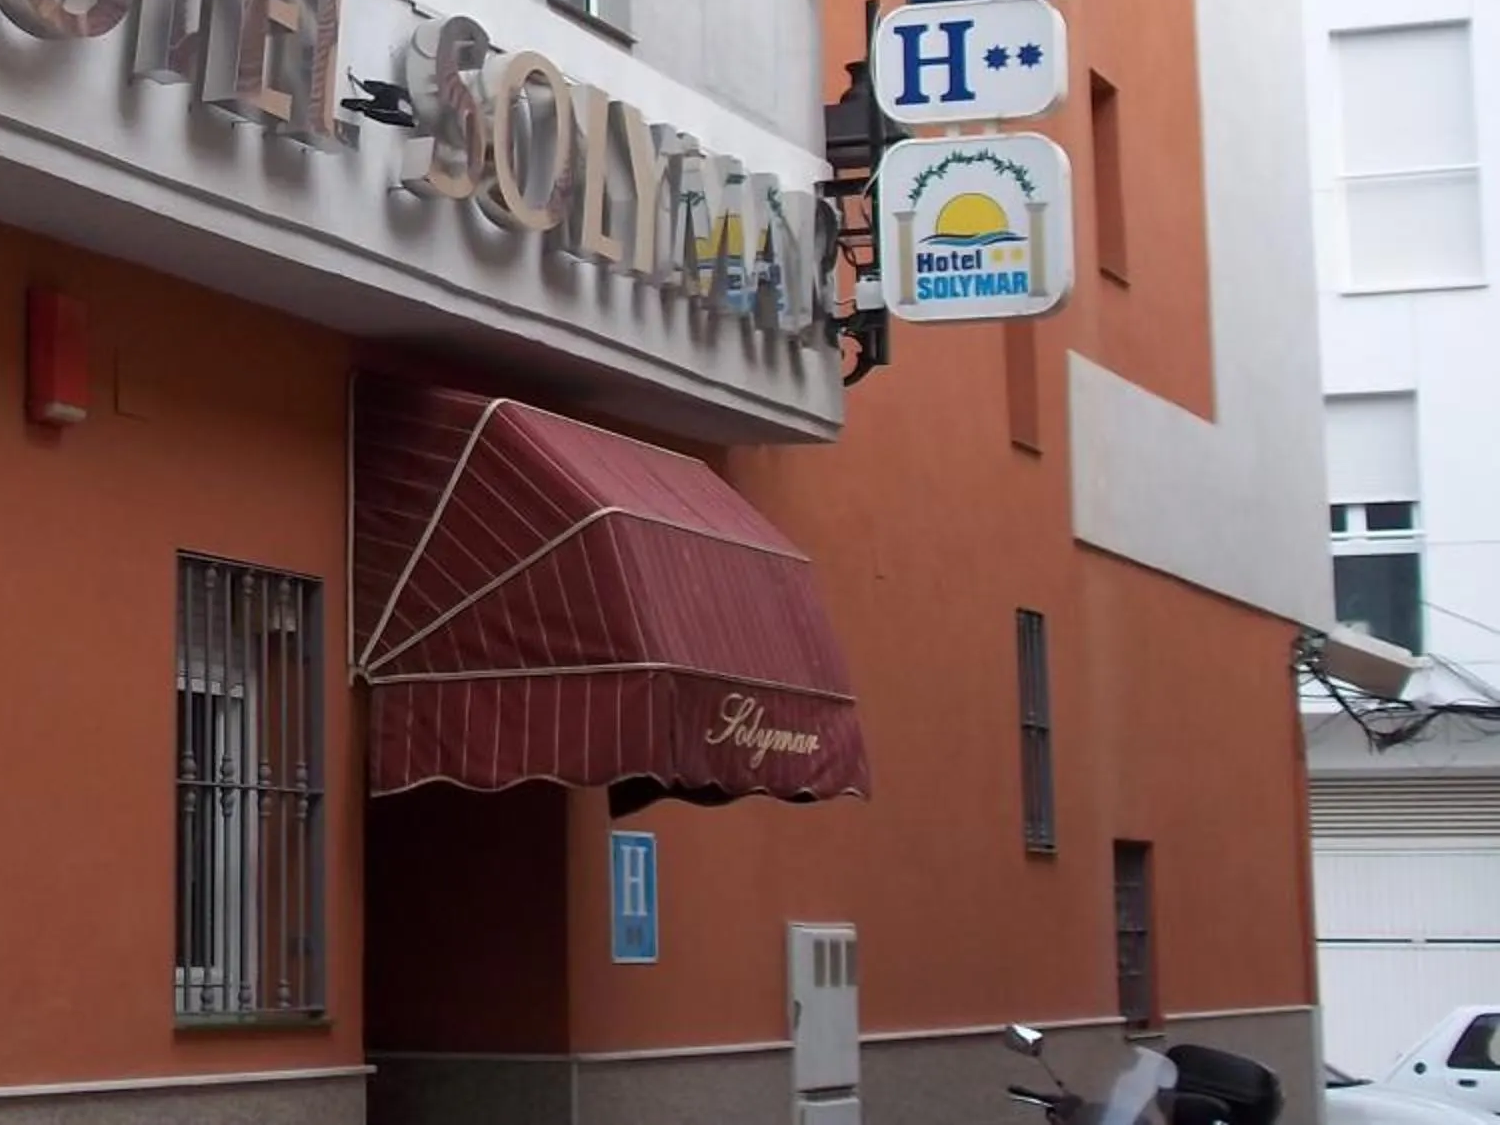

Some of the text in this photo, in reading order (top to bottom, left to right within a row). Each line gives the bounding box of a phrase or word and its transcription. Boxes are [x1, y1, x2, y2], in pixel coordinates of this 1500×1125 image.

[916, 248, 982, 273] Hotel
[916, 270, 1029, 301] SOLYMAR
[705, 692, 821, 768] Solymar
[619, 845, 649, 917] H
